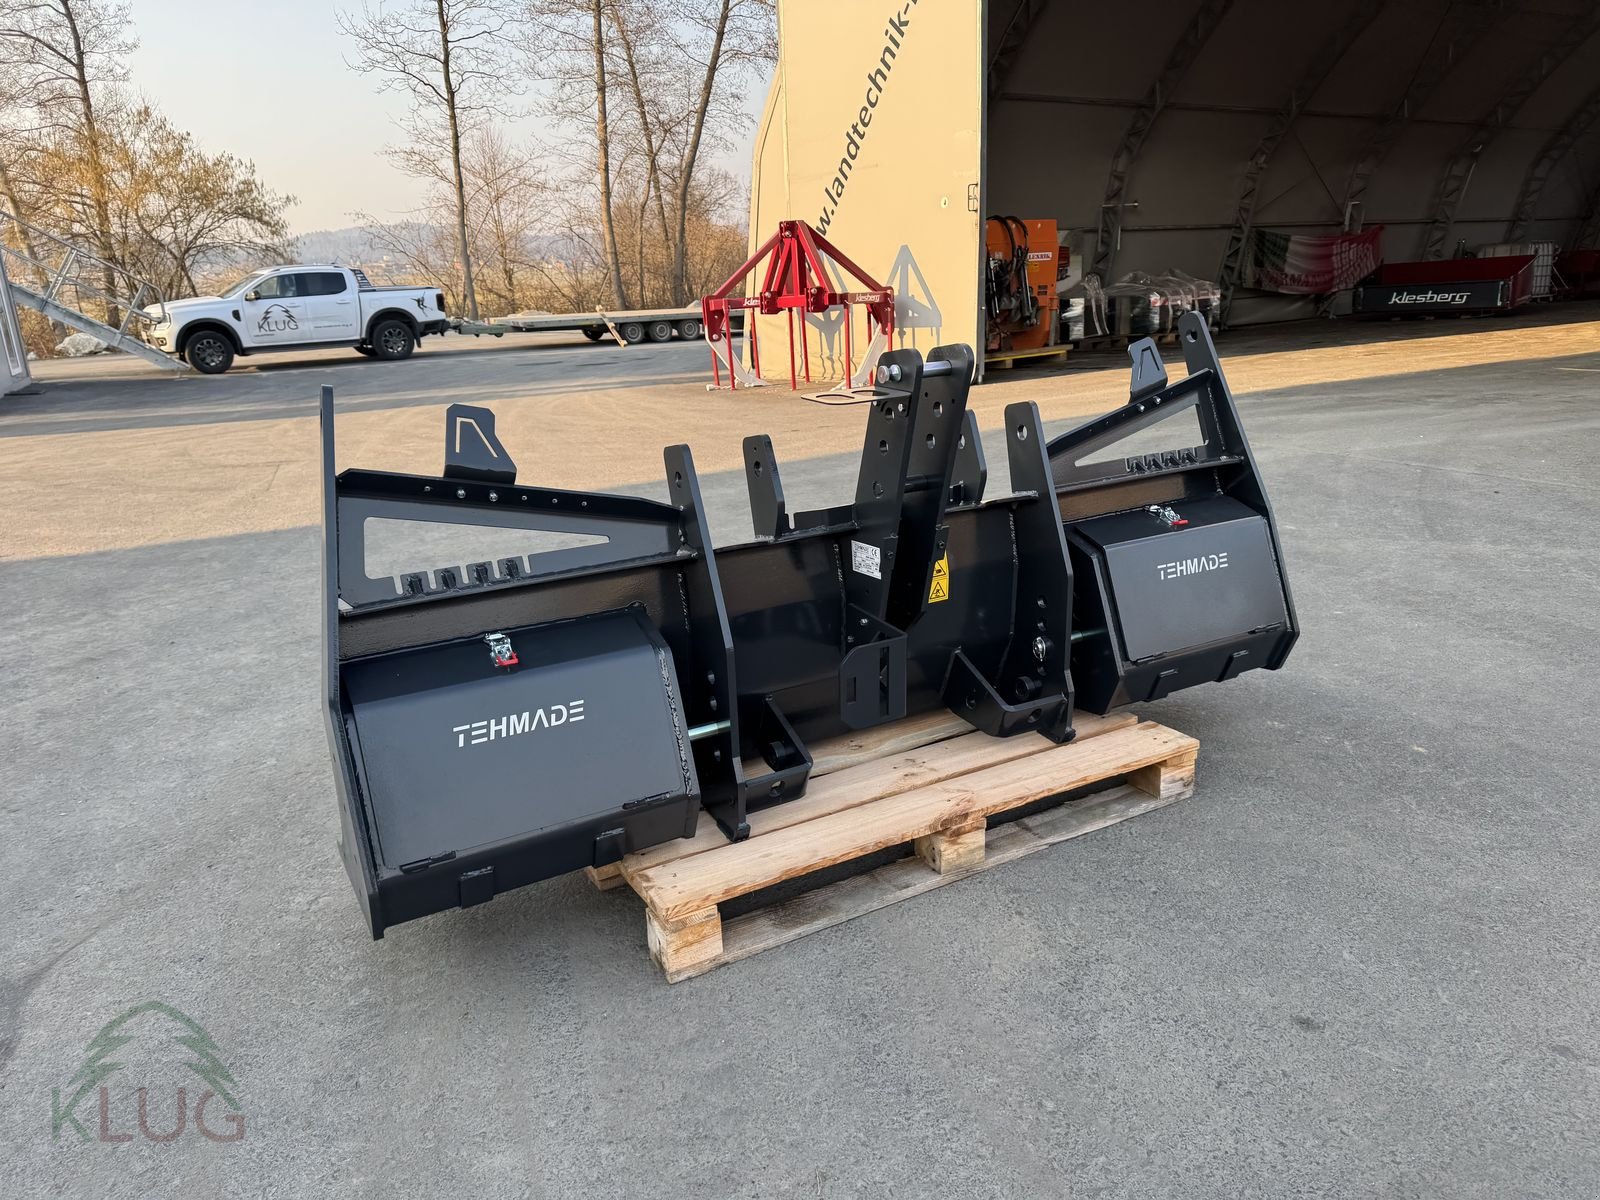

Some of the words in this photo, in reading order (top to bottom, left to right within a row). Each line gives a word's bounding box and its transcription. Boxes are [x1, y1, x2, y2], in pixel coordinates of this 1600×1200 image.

[815, 0, 918, 237] w.landtechnik-
[1388, 289, 1471, 304] klesberg
[258, 319, 299, 332] KLUG
[1157, 552, 1229, 580] TEHMADE
[453, 700, 585, 748] TEHMADE
